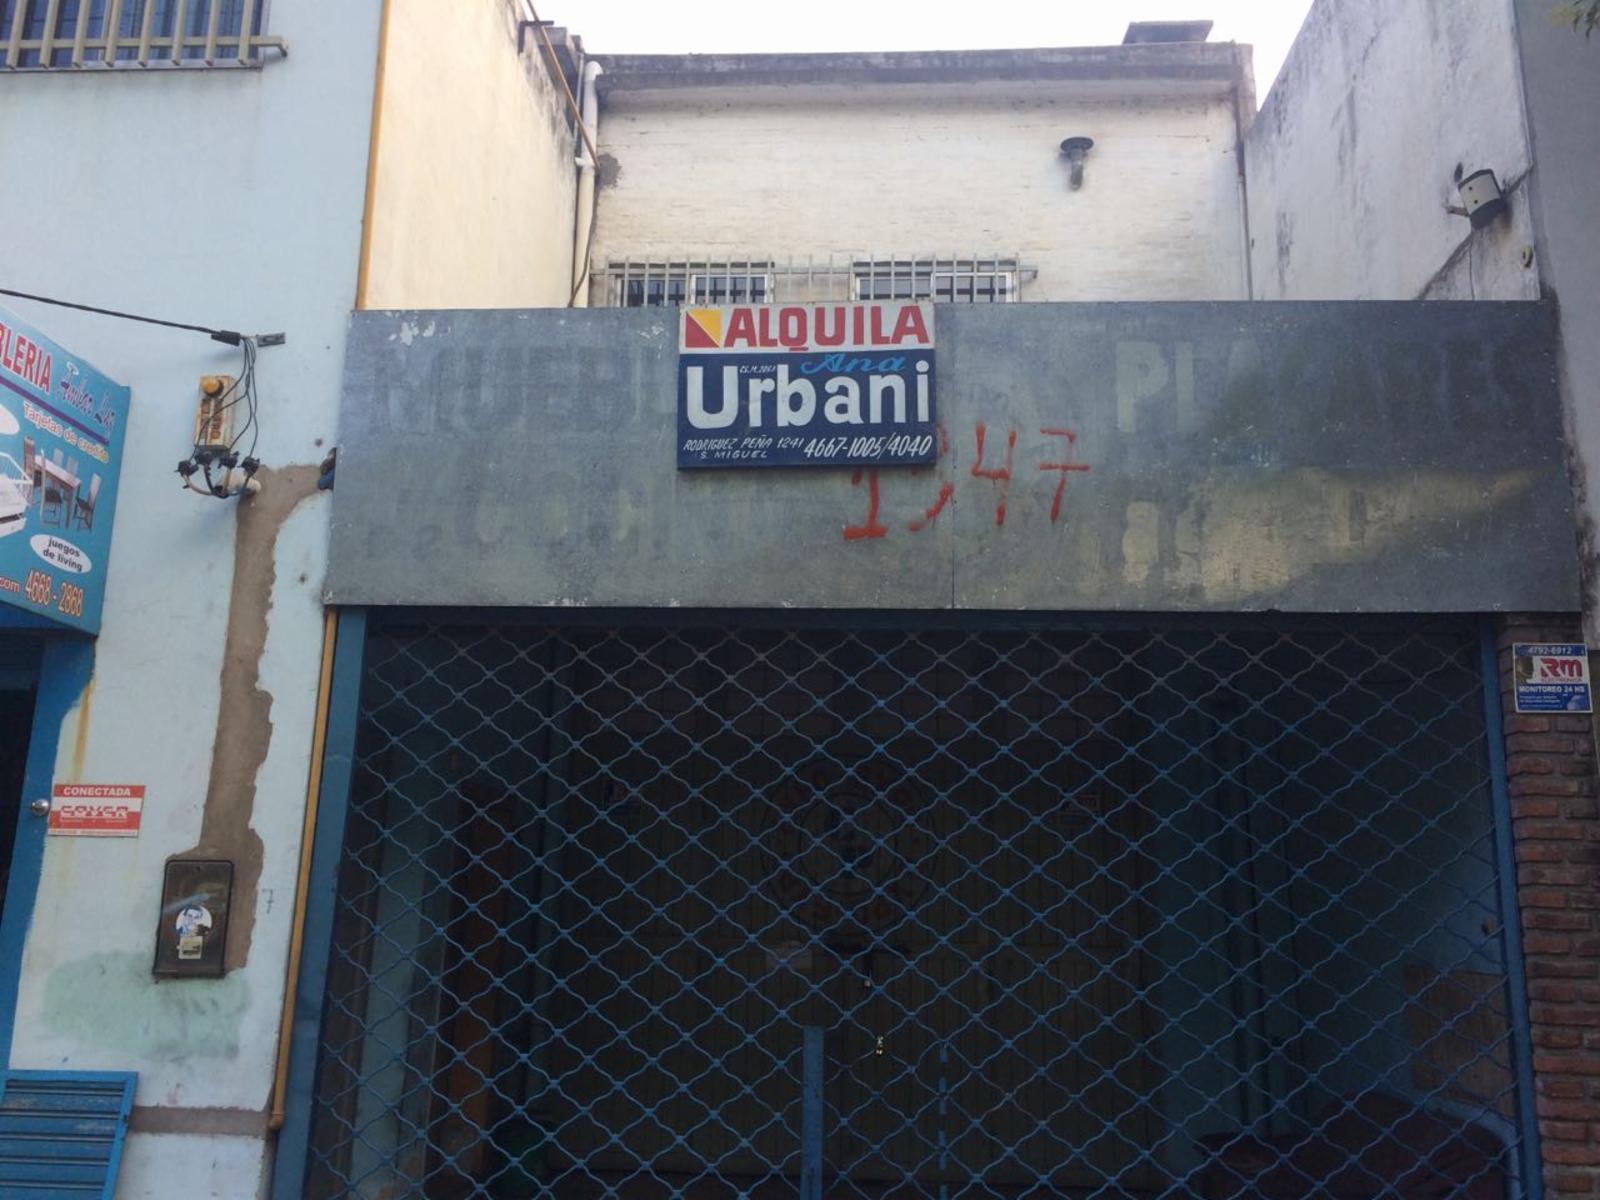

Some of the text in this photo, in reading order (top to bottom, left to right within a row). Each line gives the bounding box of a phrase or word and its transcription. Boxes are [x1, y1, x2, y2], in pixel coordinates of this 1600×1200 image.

[724, 305, 929, 351] ALQUILA
[0, 321, 52, 394] LERIA
[800, 353, 905, 375] Ana
[686, 360, 930, 429] Urbani
[740, 434, 771, 450] PEÑA
[713, 450, 768, 459] MIGUEL
[48, 537, 81, 557] juegos
[42, 548, 84, 573] de living
[1519, 685, 1562, 693] MONITOREO
[63, 786, 131, 796] CONECTADA
